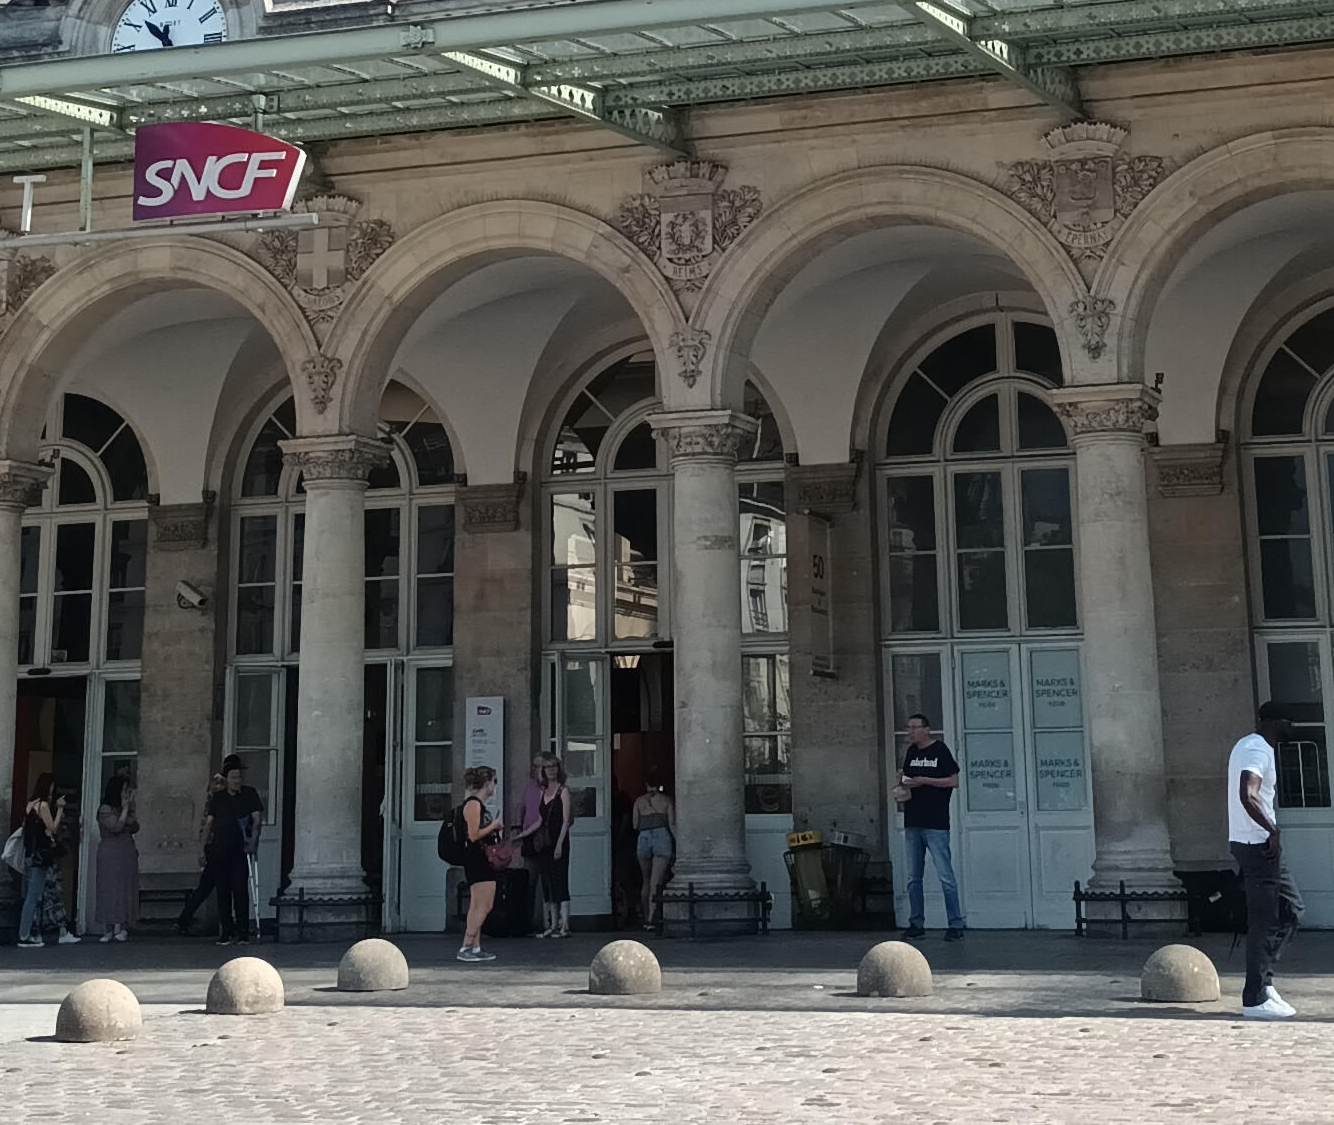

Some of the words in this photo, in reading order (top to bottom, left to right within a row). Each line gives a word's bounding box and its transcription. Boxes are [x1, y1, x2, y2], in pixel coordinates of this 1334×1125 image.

[137, 151, 287, 207] SNCF
[812, 553, 825, 580] 50
[967, 679, 999, 688] MARKS
[1036, 678, 1068, 686] MARKS
[966, 690, 1009, 699] SPENCER
[1035, 689, 1078, 698] SPENCER
[970, 760, 1002, 768] MARKS
[1040, 759, 1072, 767] MARKS
[970, 770, 1012, 779] SPENCER
[1039, 770, 1083, 779] SPENCER
